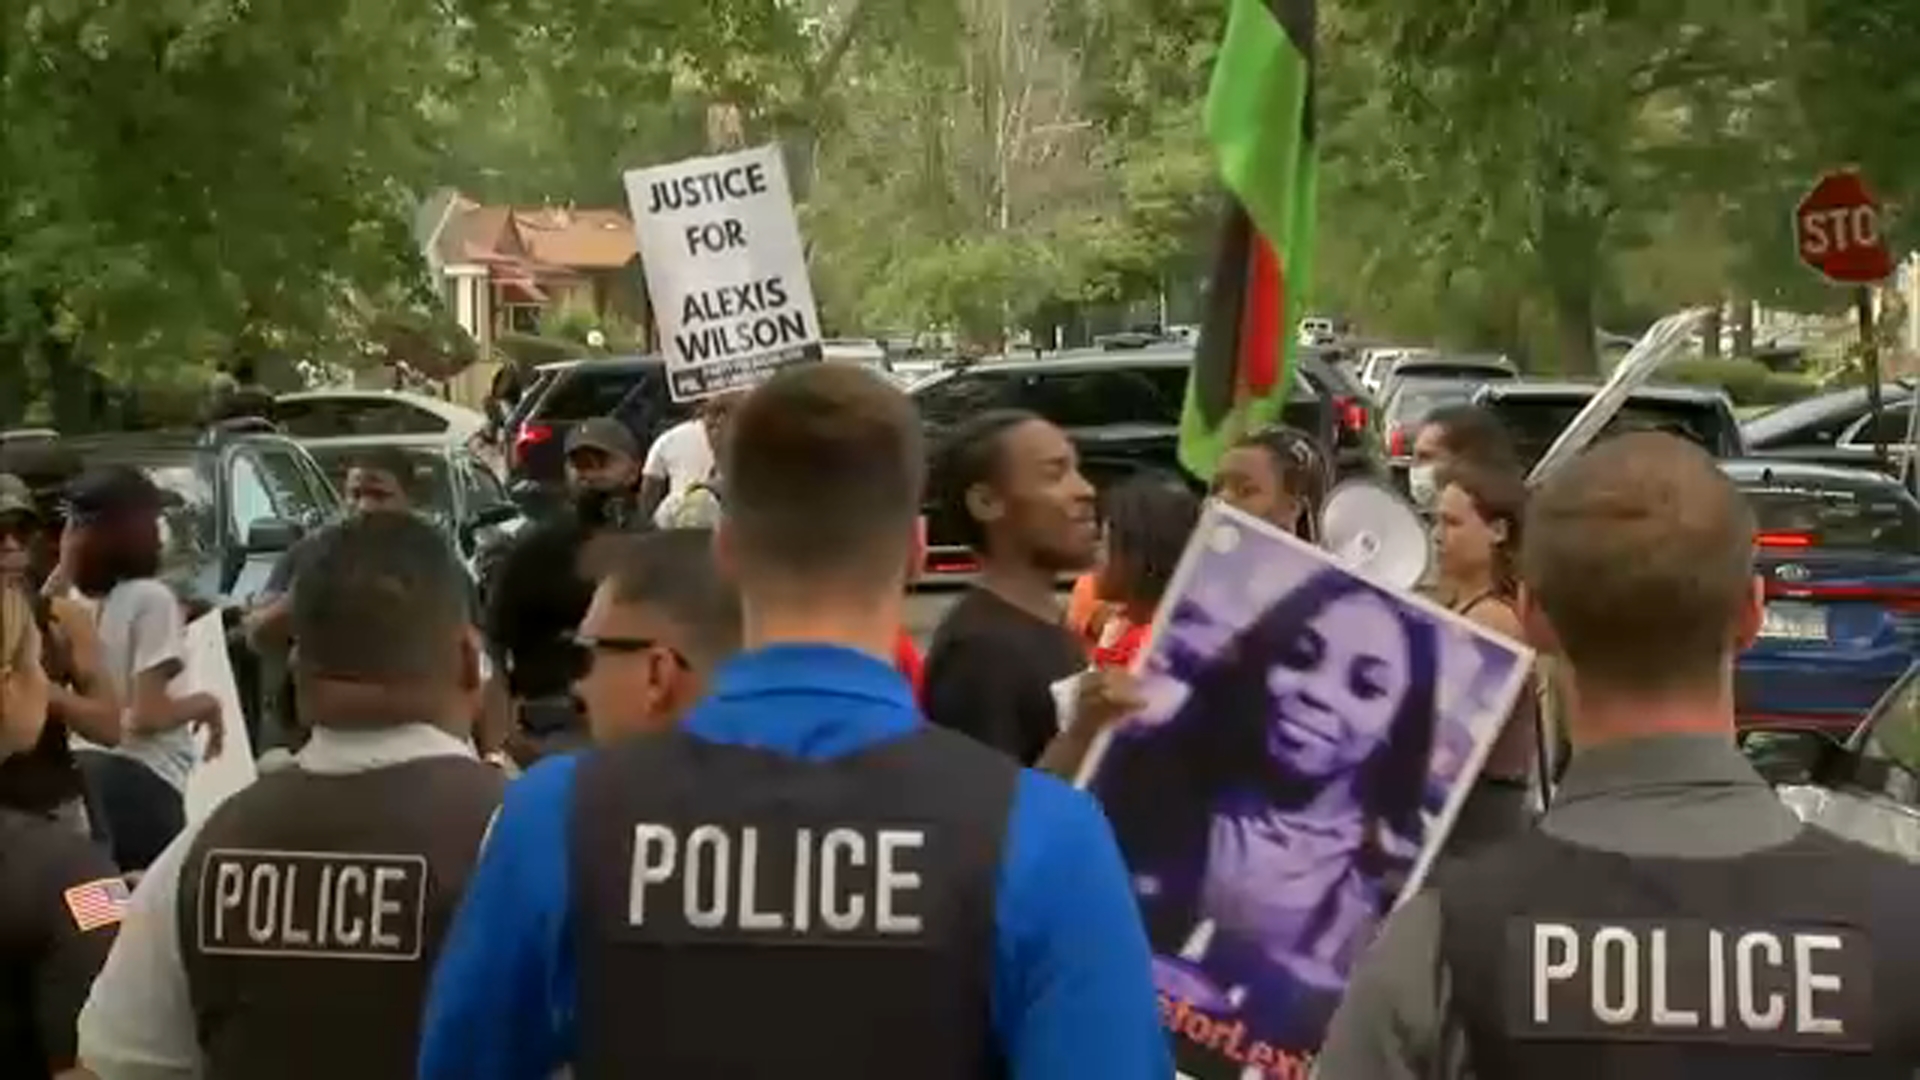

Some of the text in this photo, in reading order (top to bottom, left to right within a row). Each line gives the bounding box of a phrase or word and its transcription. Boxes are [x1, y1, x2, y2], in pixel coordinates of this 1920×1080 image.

[649, 164, 767, 214] JUSTICE
[686, 219, 746, 256] FOR
[682, 278, 787, 326] ALEXIS
[676, 311, 807, 363] WILSON
[627, 823, 924, 932] POLICE
[215, 863, 406, 947] POLICE
[1534, 923, 1844, 1033] POLICE
